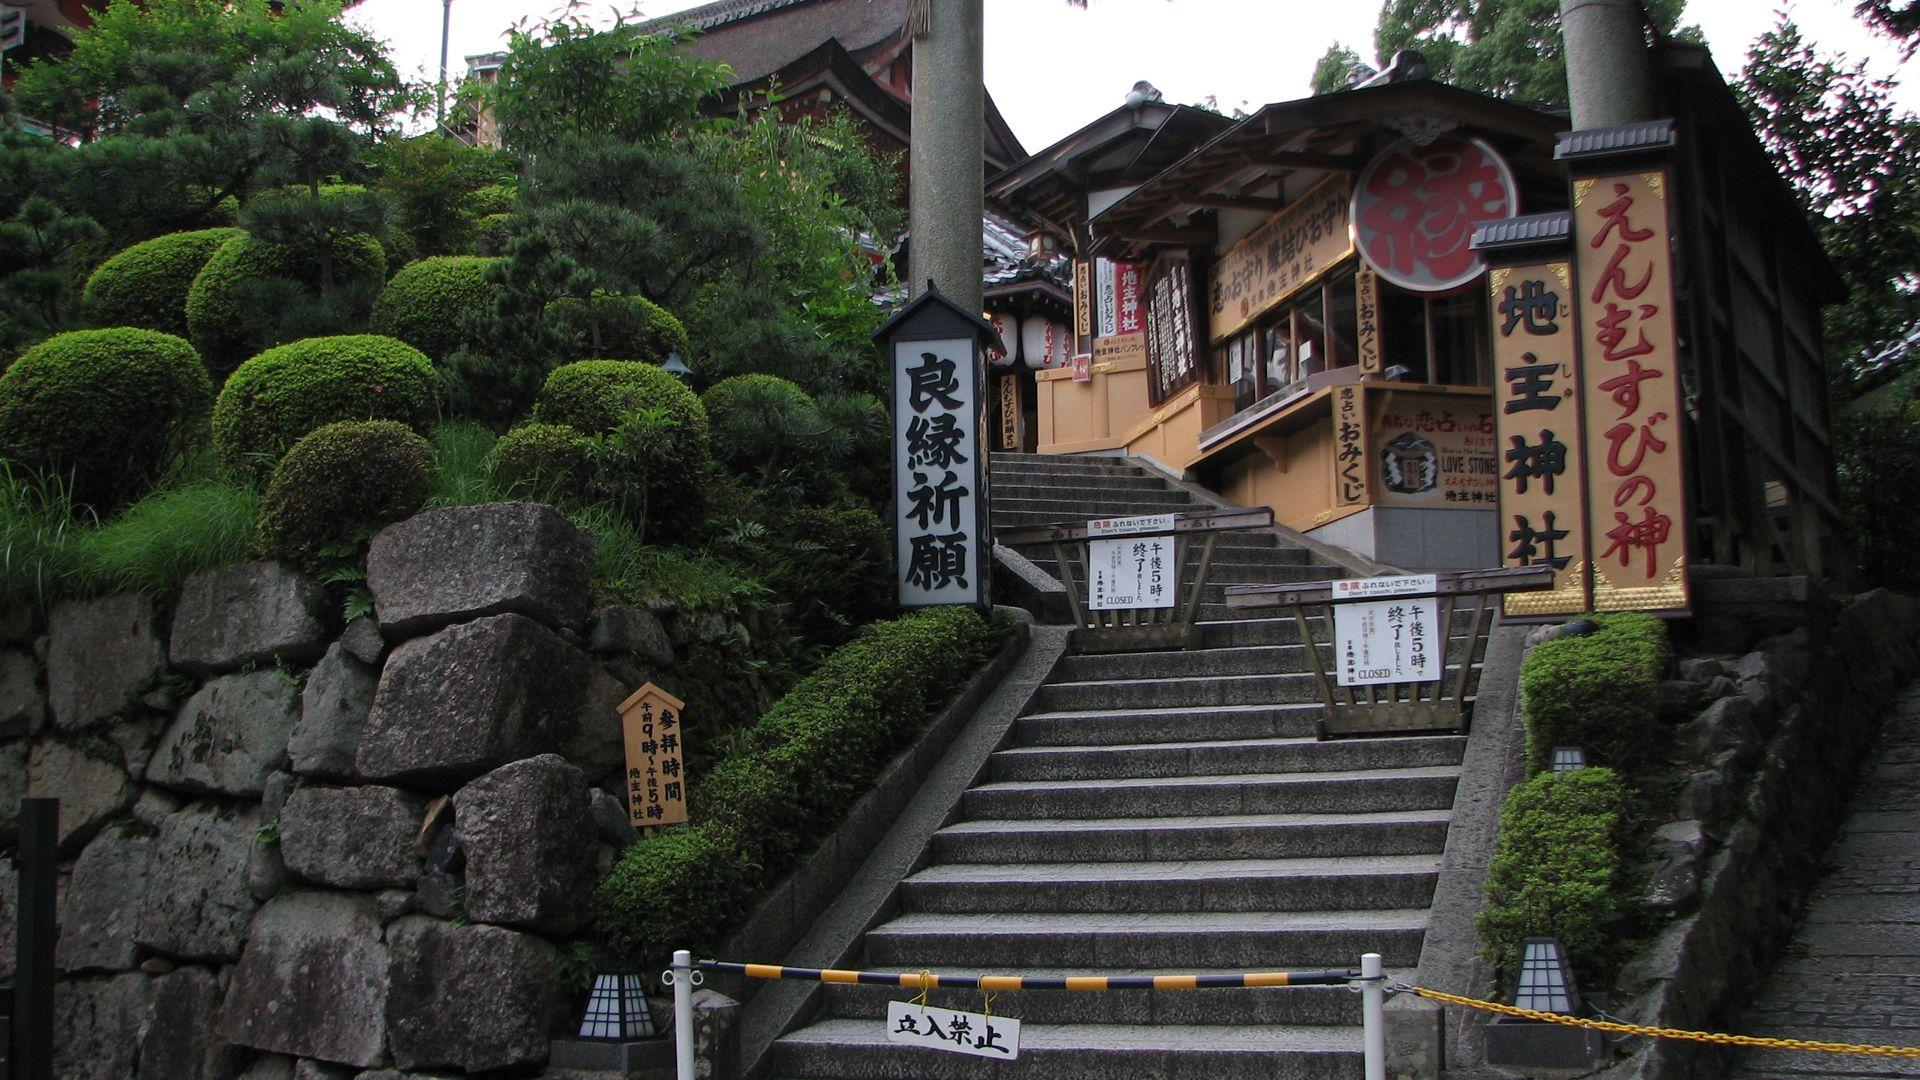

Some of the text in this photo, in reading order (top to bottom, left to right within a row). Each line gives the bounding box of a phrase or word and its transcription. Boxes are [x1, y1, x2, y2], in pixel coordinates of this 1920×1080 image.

[1122, 271, 1139, 331] 地主神社
[1590, 183, 1671, 579] えんむすびの神
[1339, 387, 1364, 502] 恋占いおみくじ
[1498, 280, 1574, 570] 地主神社
[905, 353, 969, 591] 良縁祈願
[1441, 456, 1497, 475] LOVE STONE
[1445, 490, 1497, 503] 地主神社
[1106, 596, 1133, 605] CLOSED
[1358, 669, 1391, 680] CLOSED
[629, 768, 644, 820] 地主神社
[894, 1014, 1009, 1054] 立入禁止
